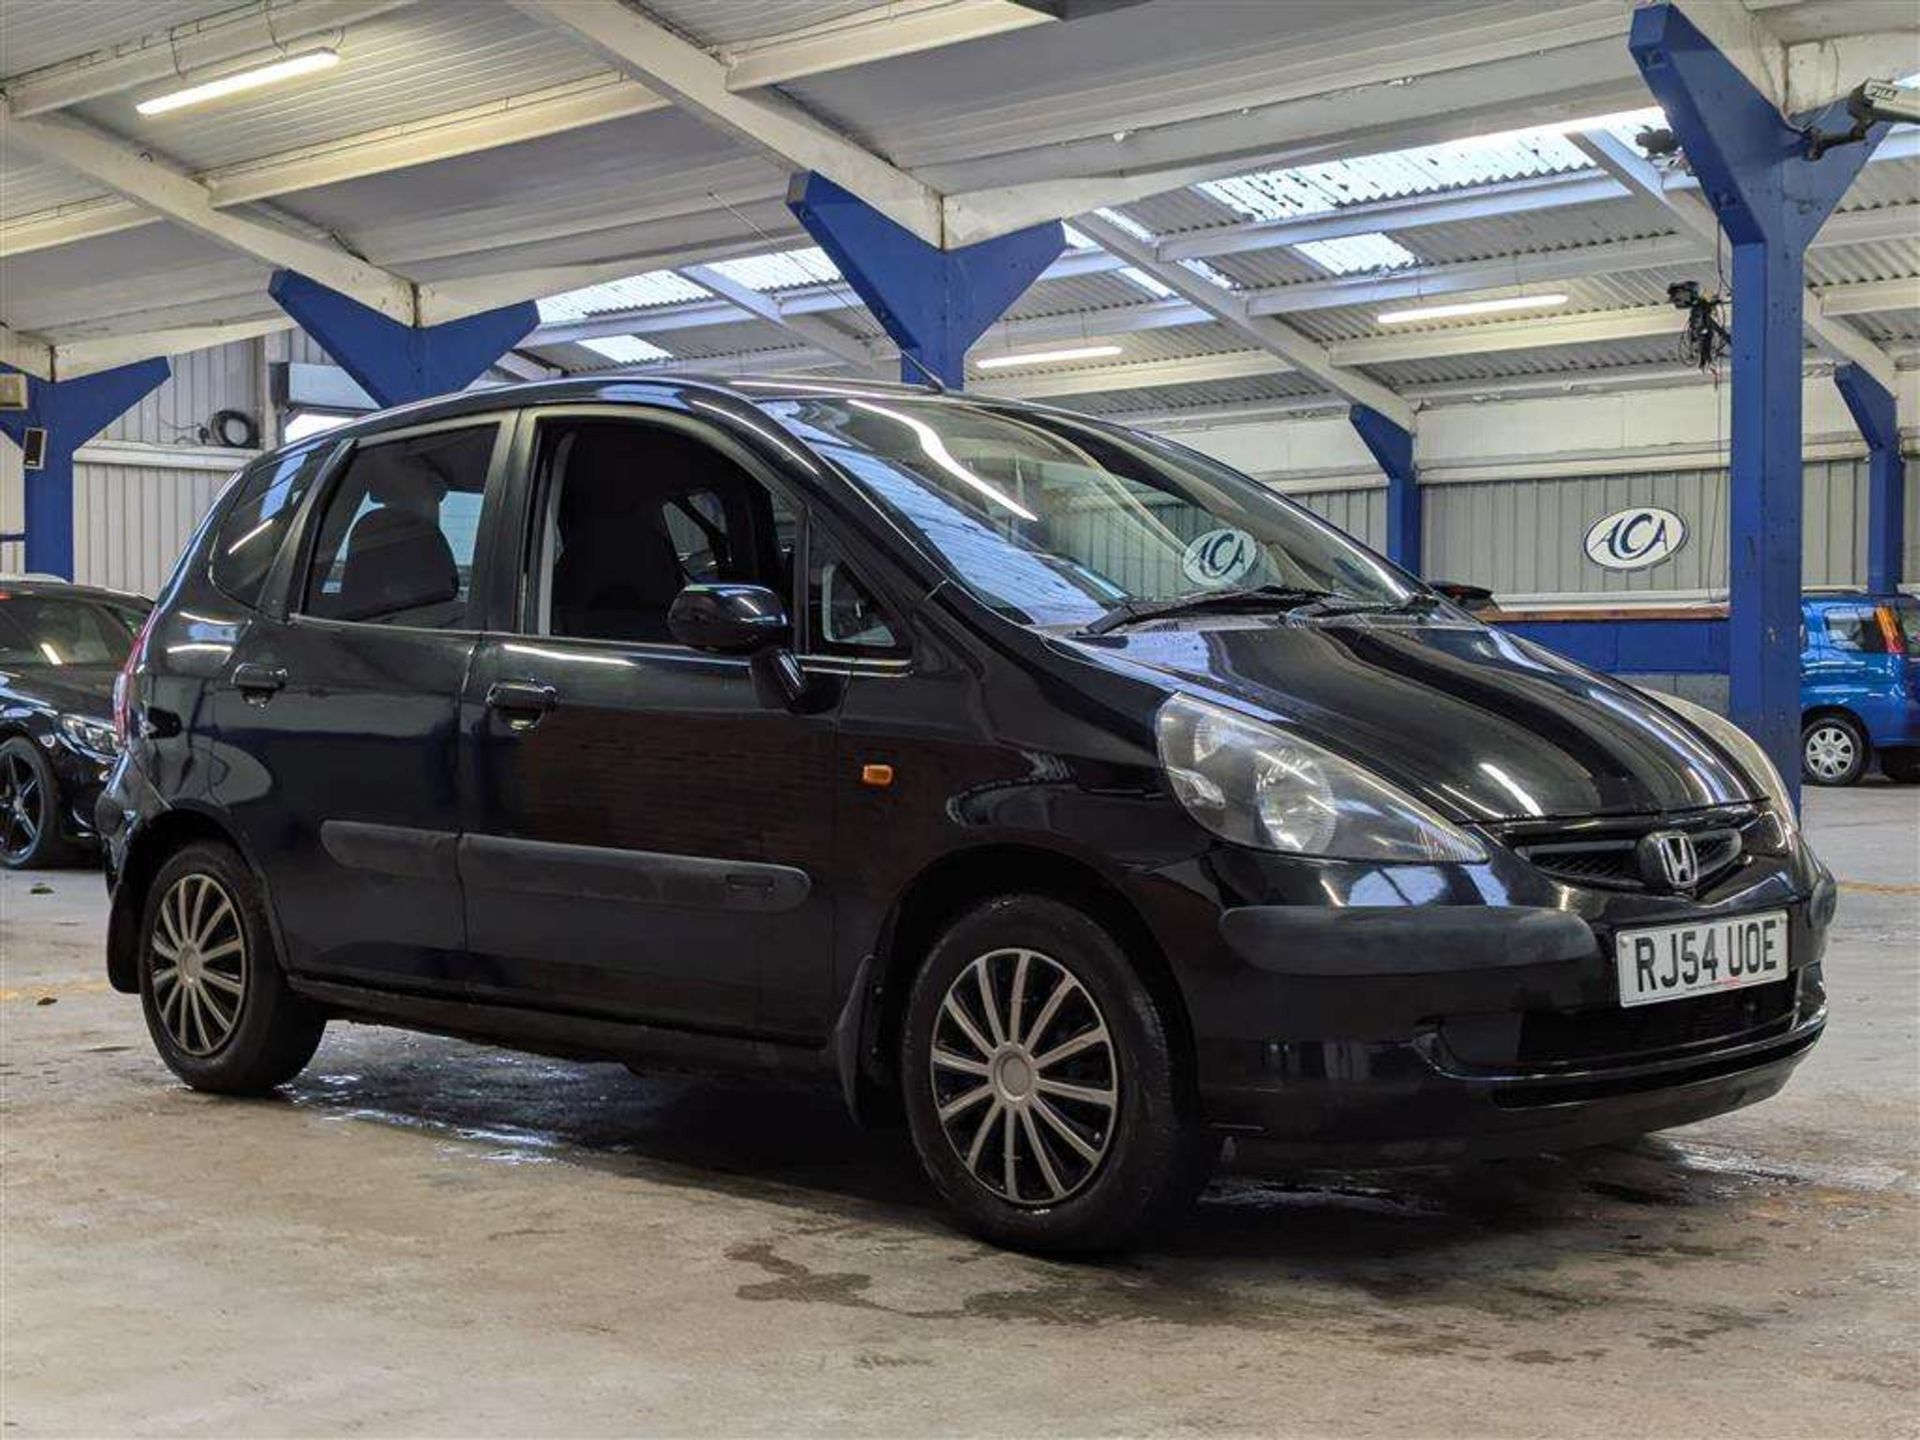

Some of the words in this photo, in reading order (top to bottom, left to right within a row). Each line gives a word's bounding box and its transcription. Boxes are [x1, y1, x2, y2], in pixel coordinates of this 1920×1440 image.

[1590, 512, 1668, 561] ACA
[1634, 927, 1718, 993] RJ54
[1727, 919, 1777, 978] UOE
